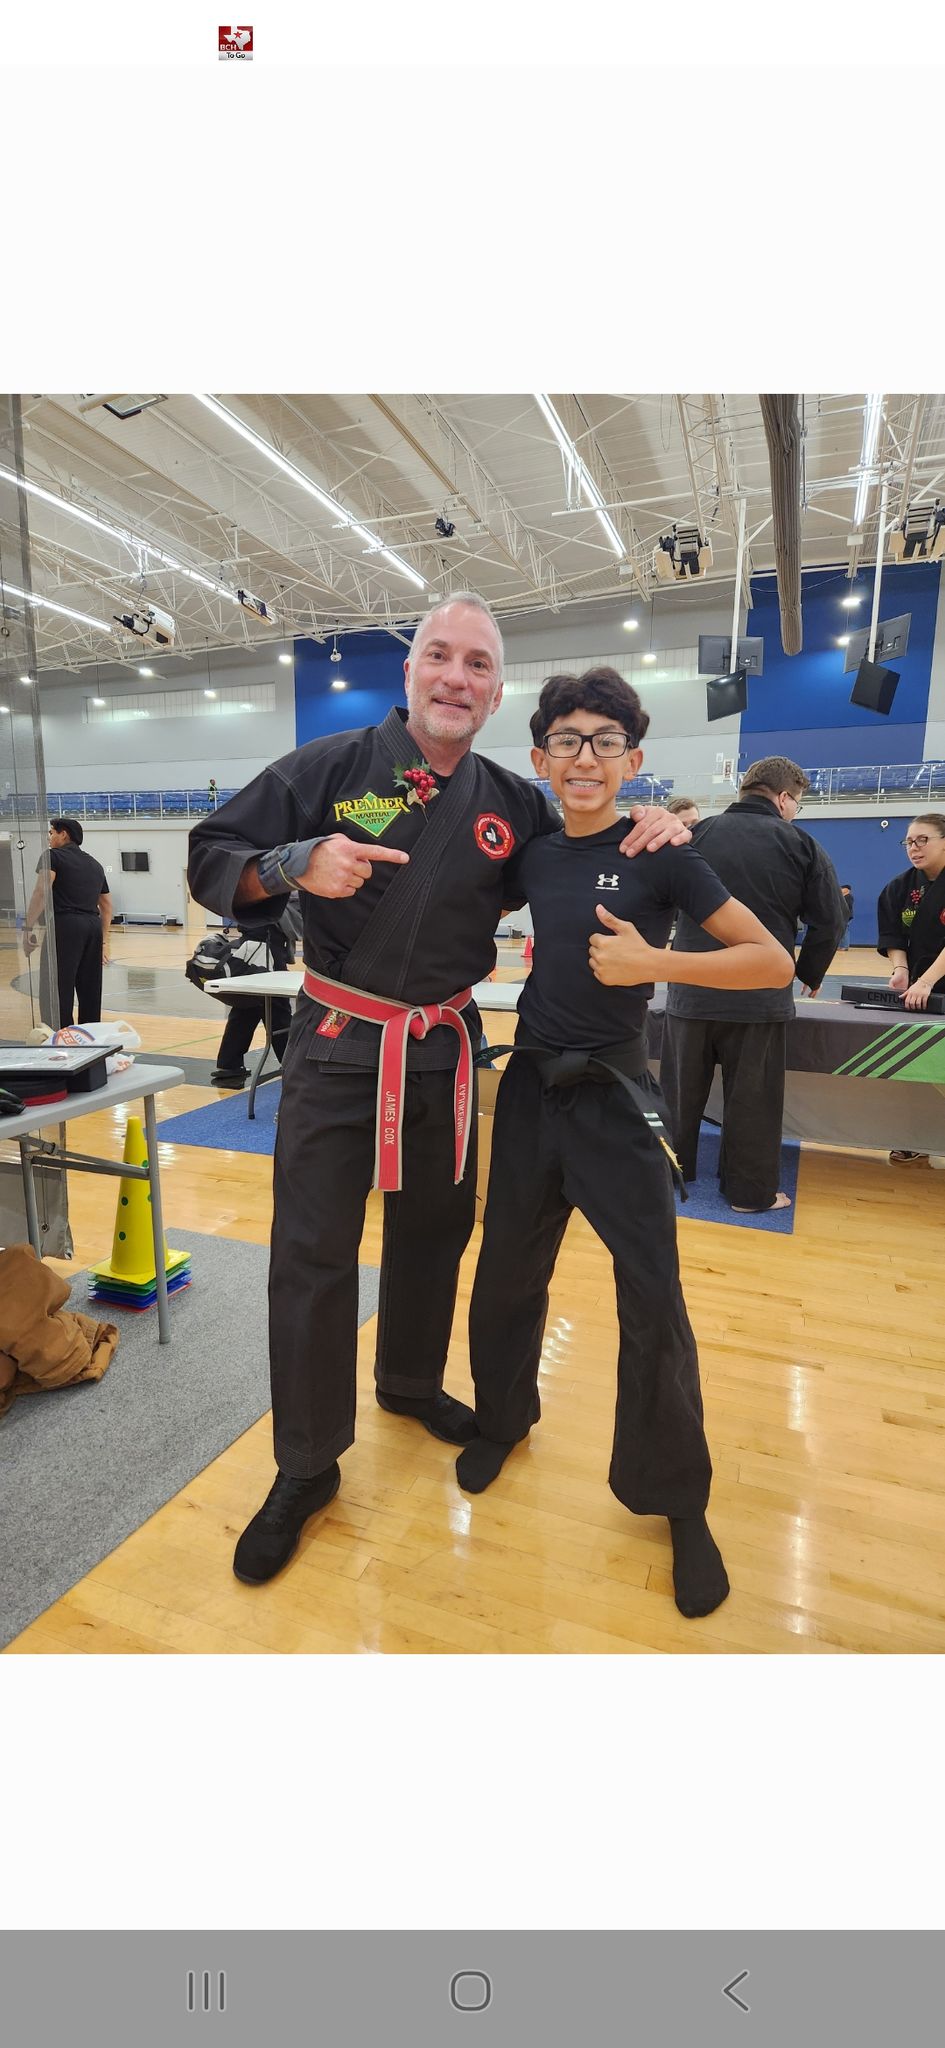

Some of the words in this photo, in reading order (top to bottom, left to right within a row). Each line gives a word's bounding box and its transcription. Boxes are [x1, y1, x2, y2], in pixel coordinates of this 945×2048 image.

[333, 797, 411, 821] PREMIER
[355, 811, 390, 819] MARTIAL
[385, 1090, 396, 1122] JAMES
[384, 1127, 395, 1145] COX
